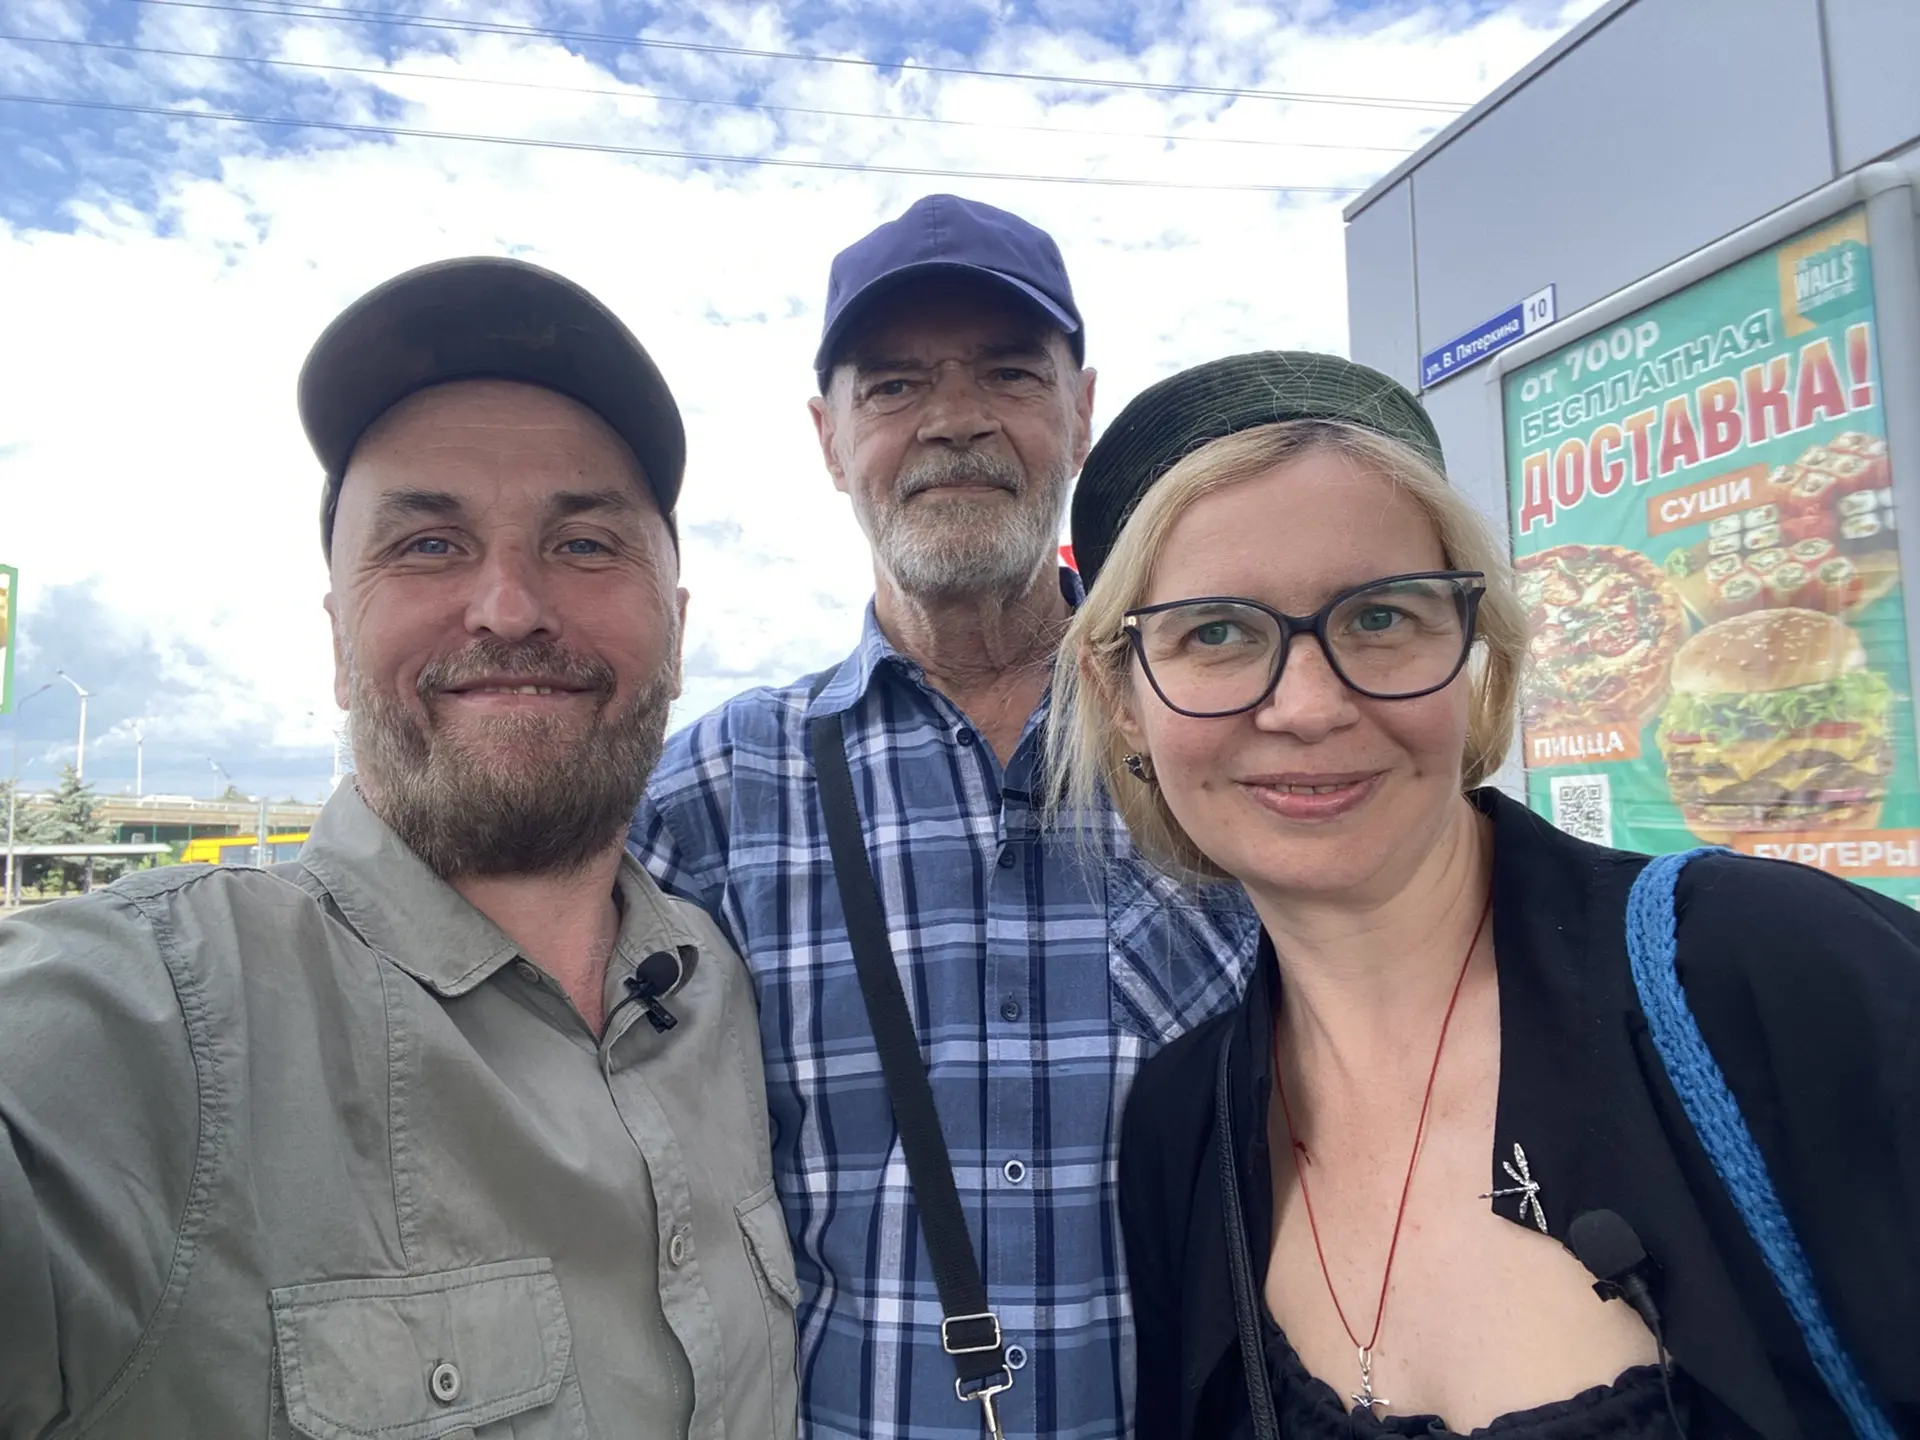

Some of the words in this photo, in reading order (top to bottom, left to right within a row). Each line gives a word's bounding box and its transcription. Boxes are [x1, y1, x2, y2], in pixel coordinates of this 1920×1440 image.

[1529, 298, 1547, 322] 10
[1521, 309, 1774, 447] БЕСПЛАТНАЯ
[1519, 322, 1876, 534] ДОСТАВКА!
[1660, 476, 1753, 523] СУШИ
[1533, 730, 1625, 759] ПИЦЦА
